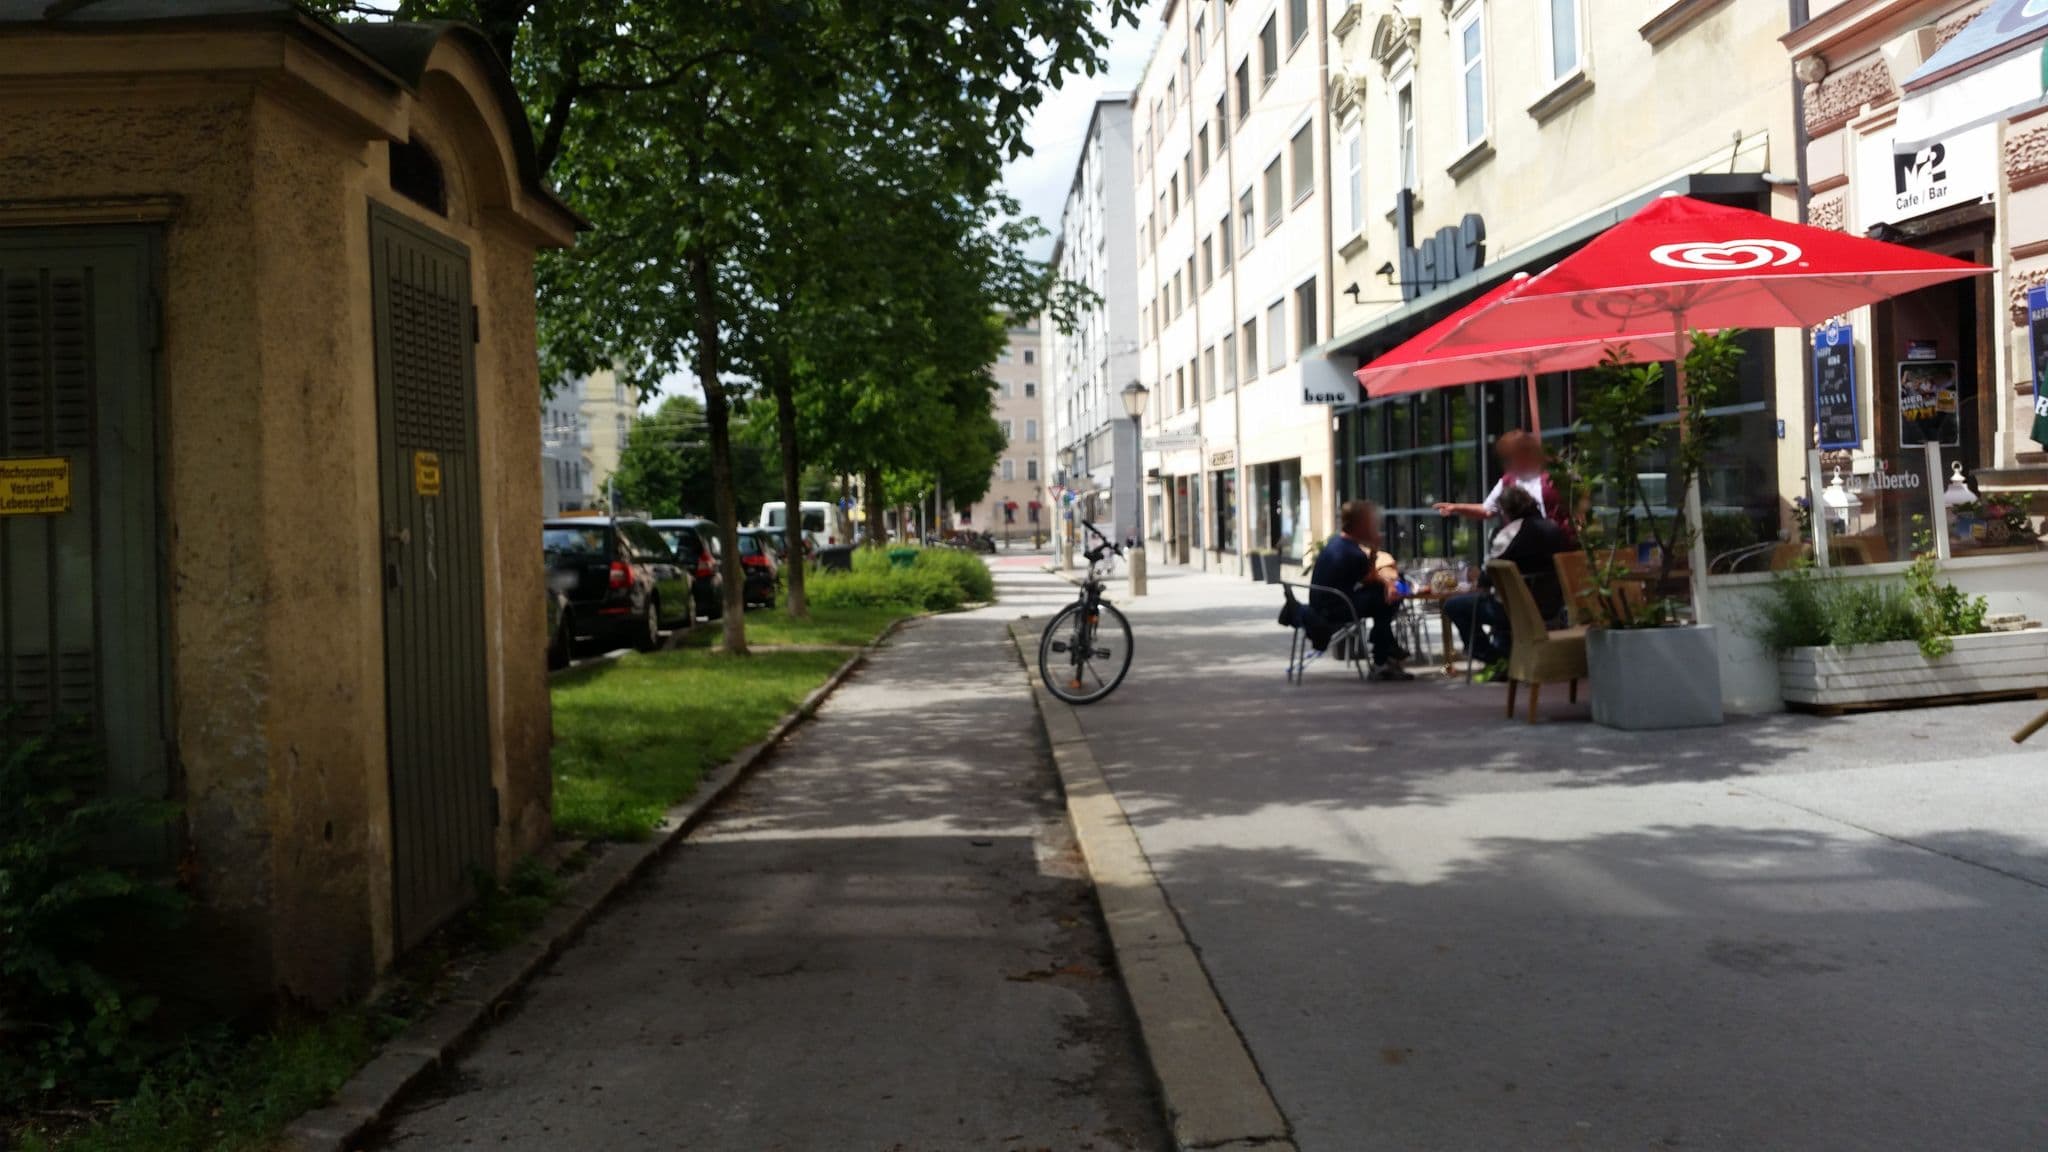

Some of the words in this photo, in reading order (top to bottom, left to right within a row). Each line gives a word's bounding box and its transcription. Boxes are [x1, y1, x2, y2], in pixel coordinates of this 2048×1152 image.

[1896, 193, 1919, 210] Cafe
[1928, 186, 1948, 200] Bar
[1304, 387, 1345, 402] bene
[1867, 470, 1920, 490] Alberto
